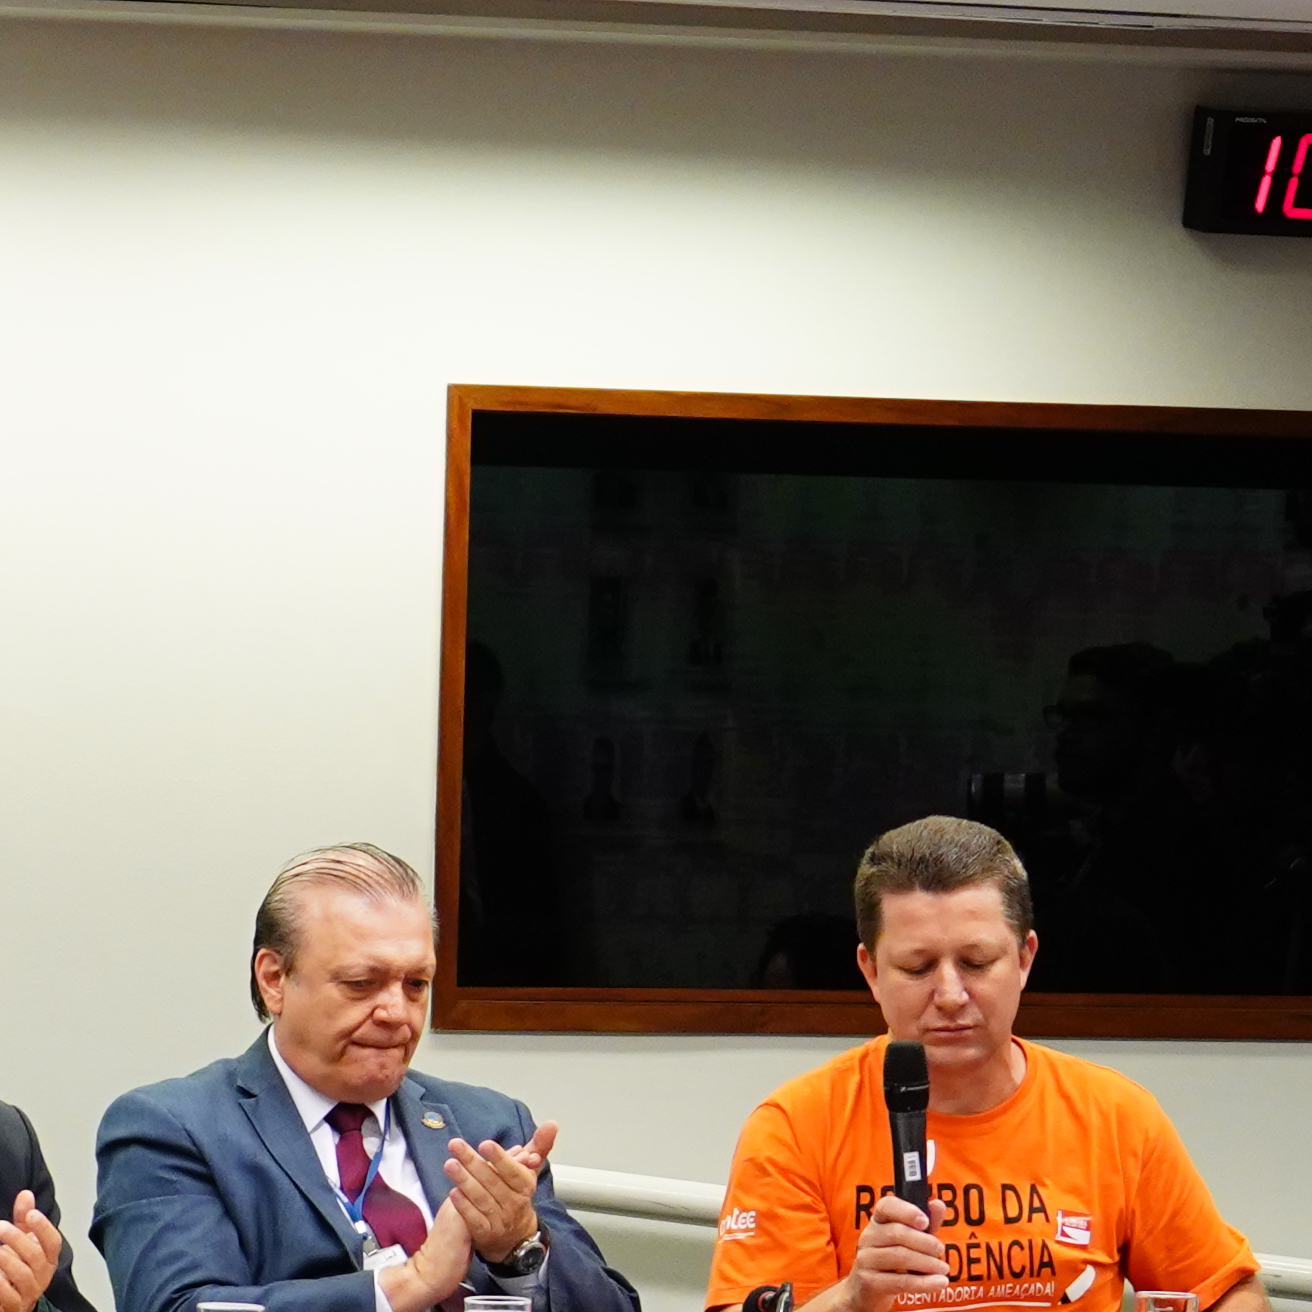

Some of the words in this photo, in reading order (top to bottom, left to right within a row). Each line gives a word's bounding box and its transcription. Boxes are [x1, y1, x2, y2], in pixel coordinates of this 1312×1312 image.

[854, 1182, 986, 1230] RBO
[1000, 1182, 1050, 1225] DA
[987, 1281, 1055, 1299] AMEAÇADA!
